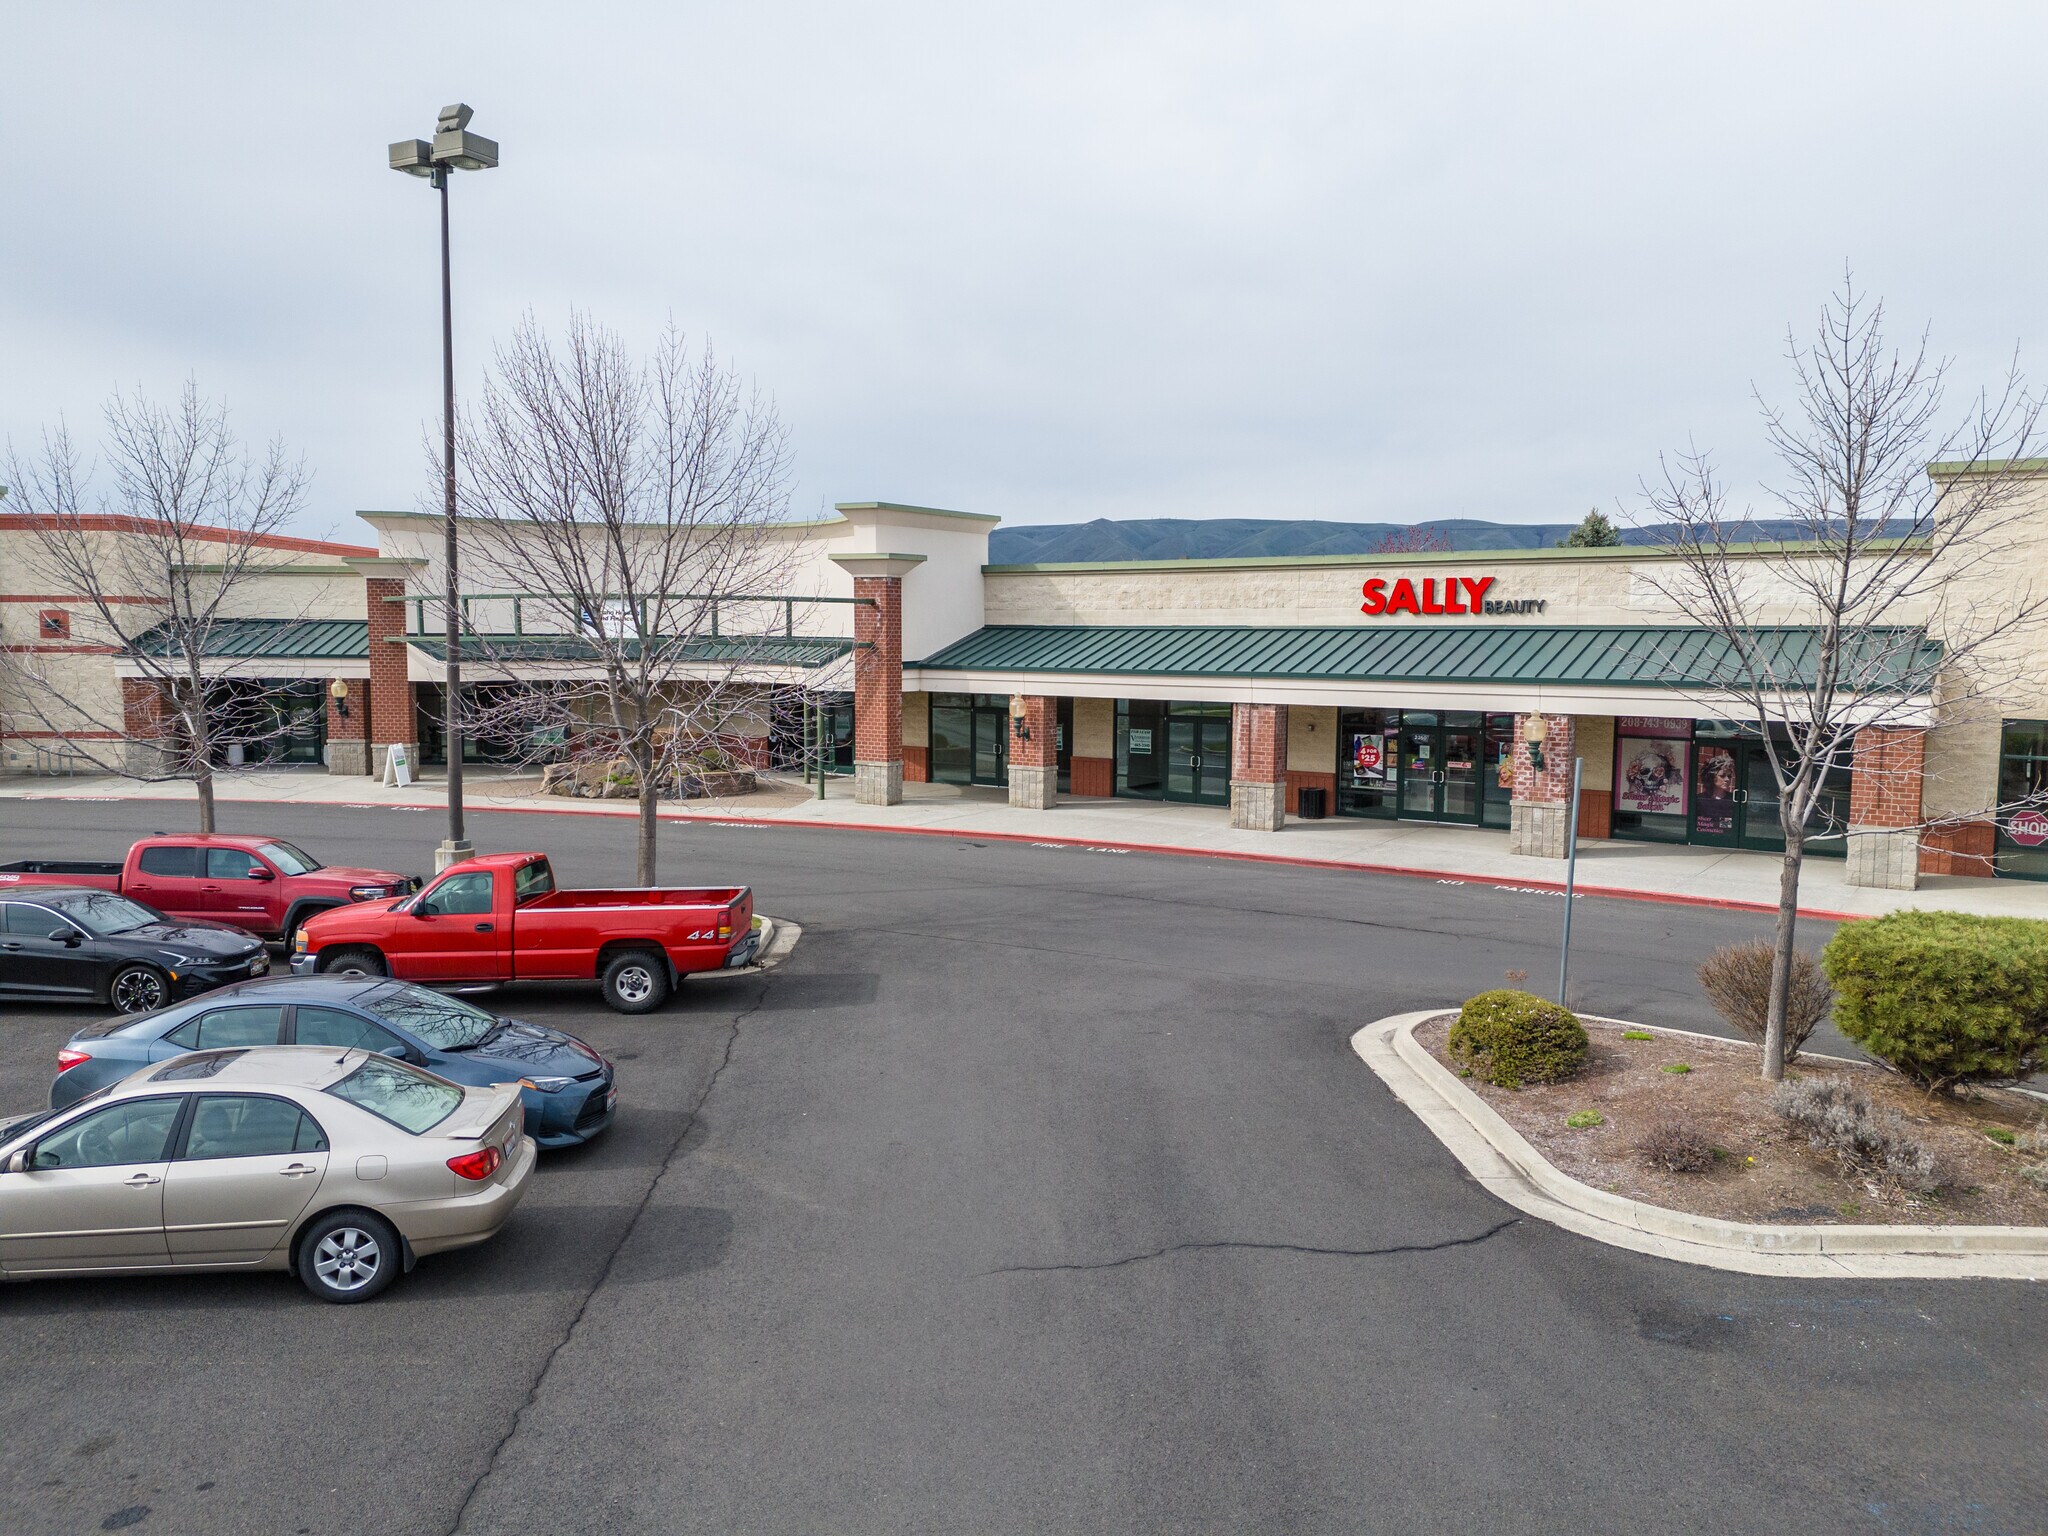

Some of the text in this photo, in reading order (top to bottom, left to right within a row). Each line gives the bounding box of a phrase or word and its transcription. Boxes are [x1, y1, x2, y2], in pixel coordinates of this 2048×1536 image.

[1360, 577, 1546, 615] SALLY BEAUTY
[2010, 820, 2048, 836] SHOP
